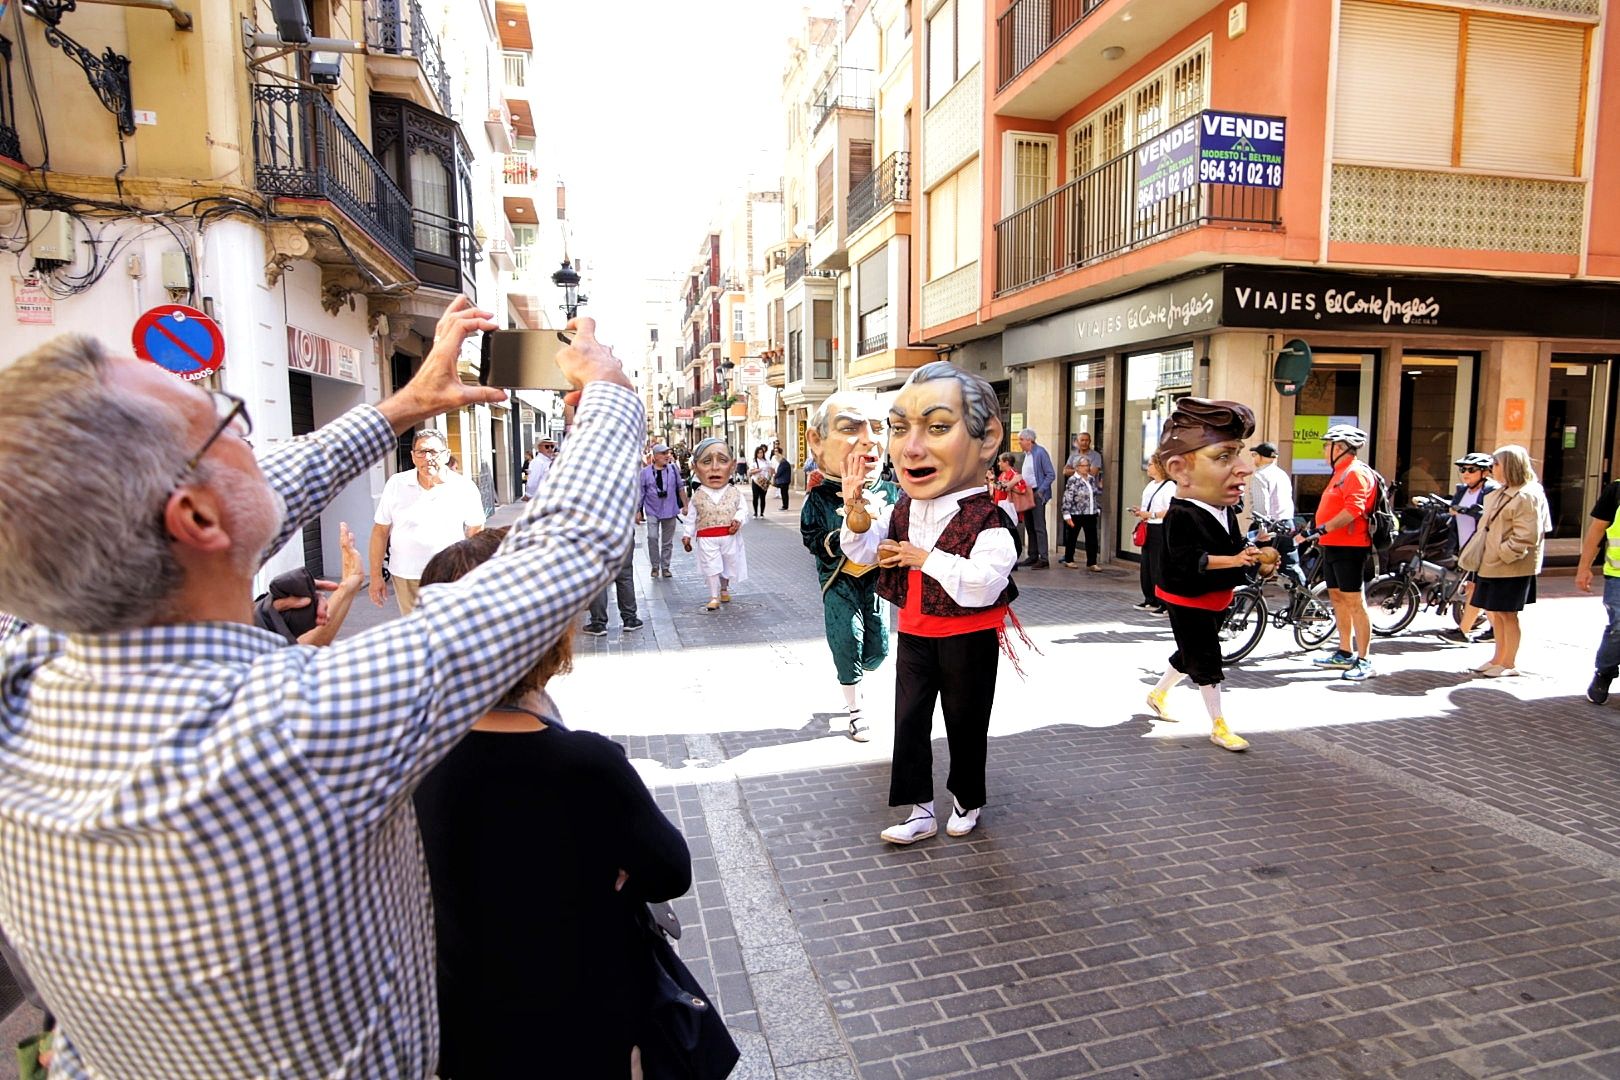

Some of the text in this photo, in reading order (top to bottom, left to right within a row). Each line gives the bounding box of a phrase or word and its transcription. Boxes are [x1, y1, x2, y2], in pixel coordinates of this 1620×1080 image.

[1202, 115, 1284, 141] VENDE
[1139, 120, 1195, 167] VENDE
[1201, 150, 1282, 164] MODESTO L. BELTRAN
[1138, 164, 1194, 209] 964 31 02 18
[1200, 159, 1282, 187] 964 31 02 18
[1077, 315, 1122, 339] VIAJES
[1139, 304, 1167, 327] Corte
[1167, 292, 1214, 330] Inglés
[1235, 287, 1316, 314] VIAJES
[1343, 290, 1382, 316] Corte
[1382, 286, 1440, 324] Inglés
[184, 367, 213, 381] LADOS
[1293, 428, 1319, 440] EY LEÓN
